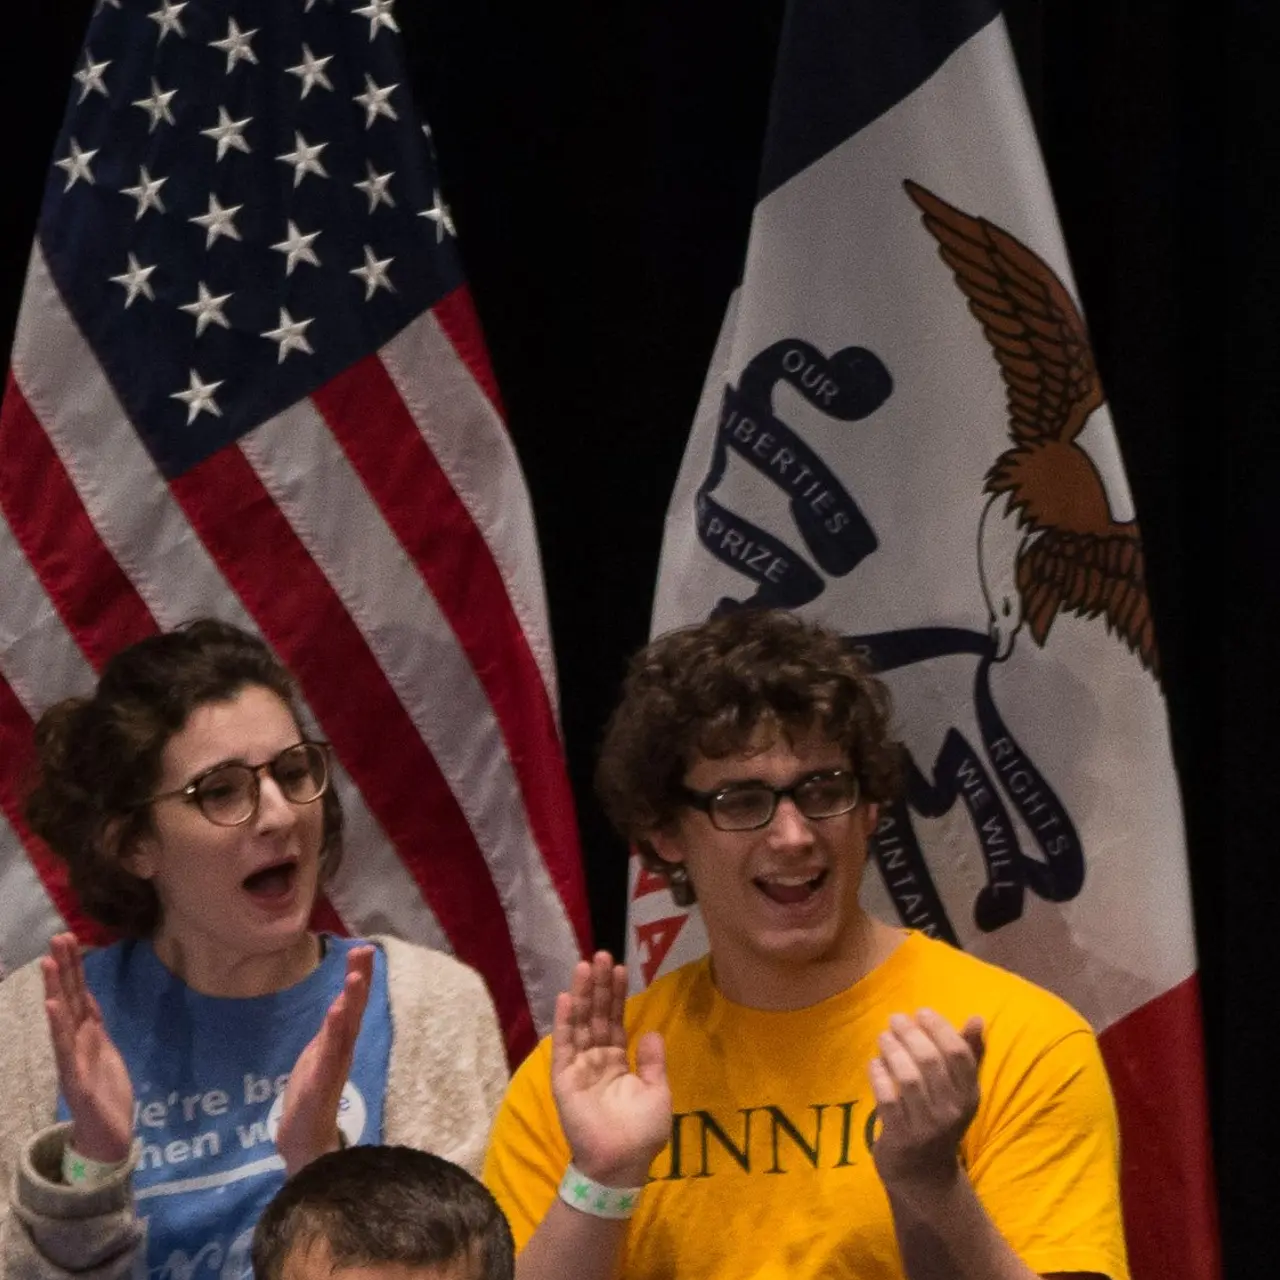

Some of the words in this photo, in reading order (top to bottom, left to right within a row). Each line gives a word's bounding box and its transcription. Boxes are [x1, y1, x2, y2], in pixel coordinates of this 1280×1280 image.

[781, 350, 840, 406] OUR
[724, 410, 850, 535] IBERTIES
[706, 517, 790, 584] PRIZE
[955, 757, 990, 813] WE
[980, 814, 1016, 897] WILL
[990, 736, 1071, 857] RIGHTS
[133, 1088, 231, 1132] e're
[135, 1129, 222, 1172] hen
